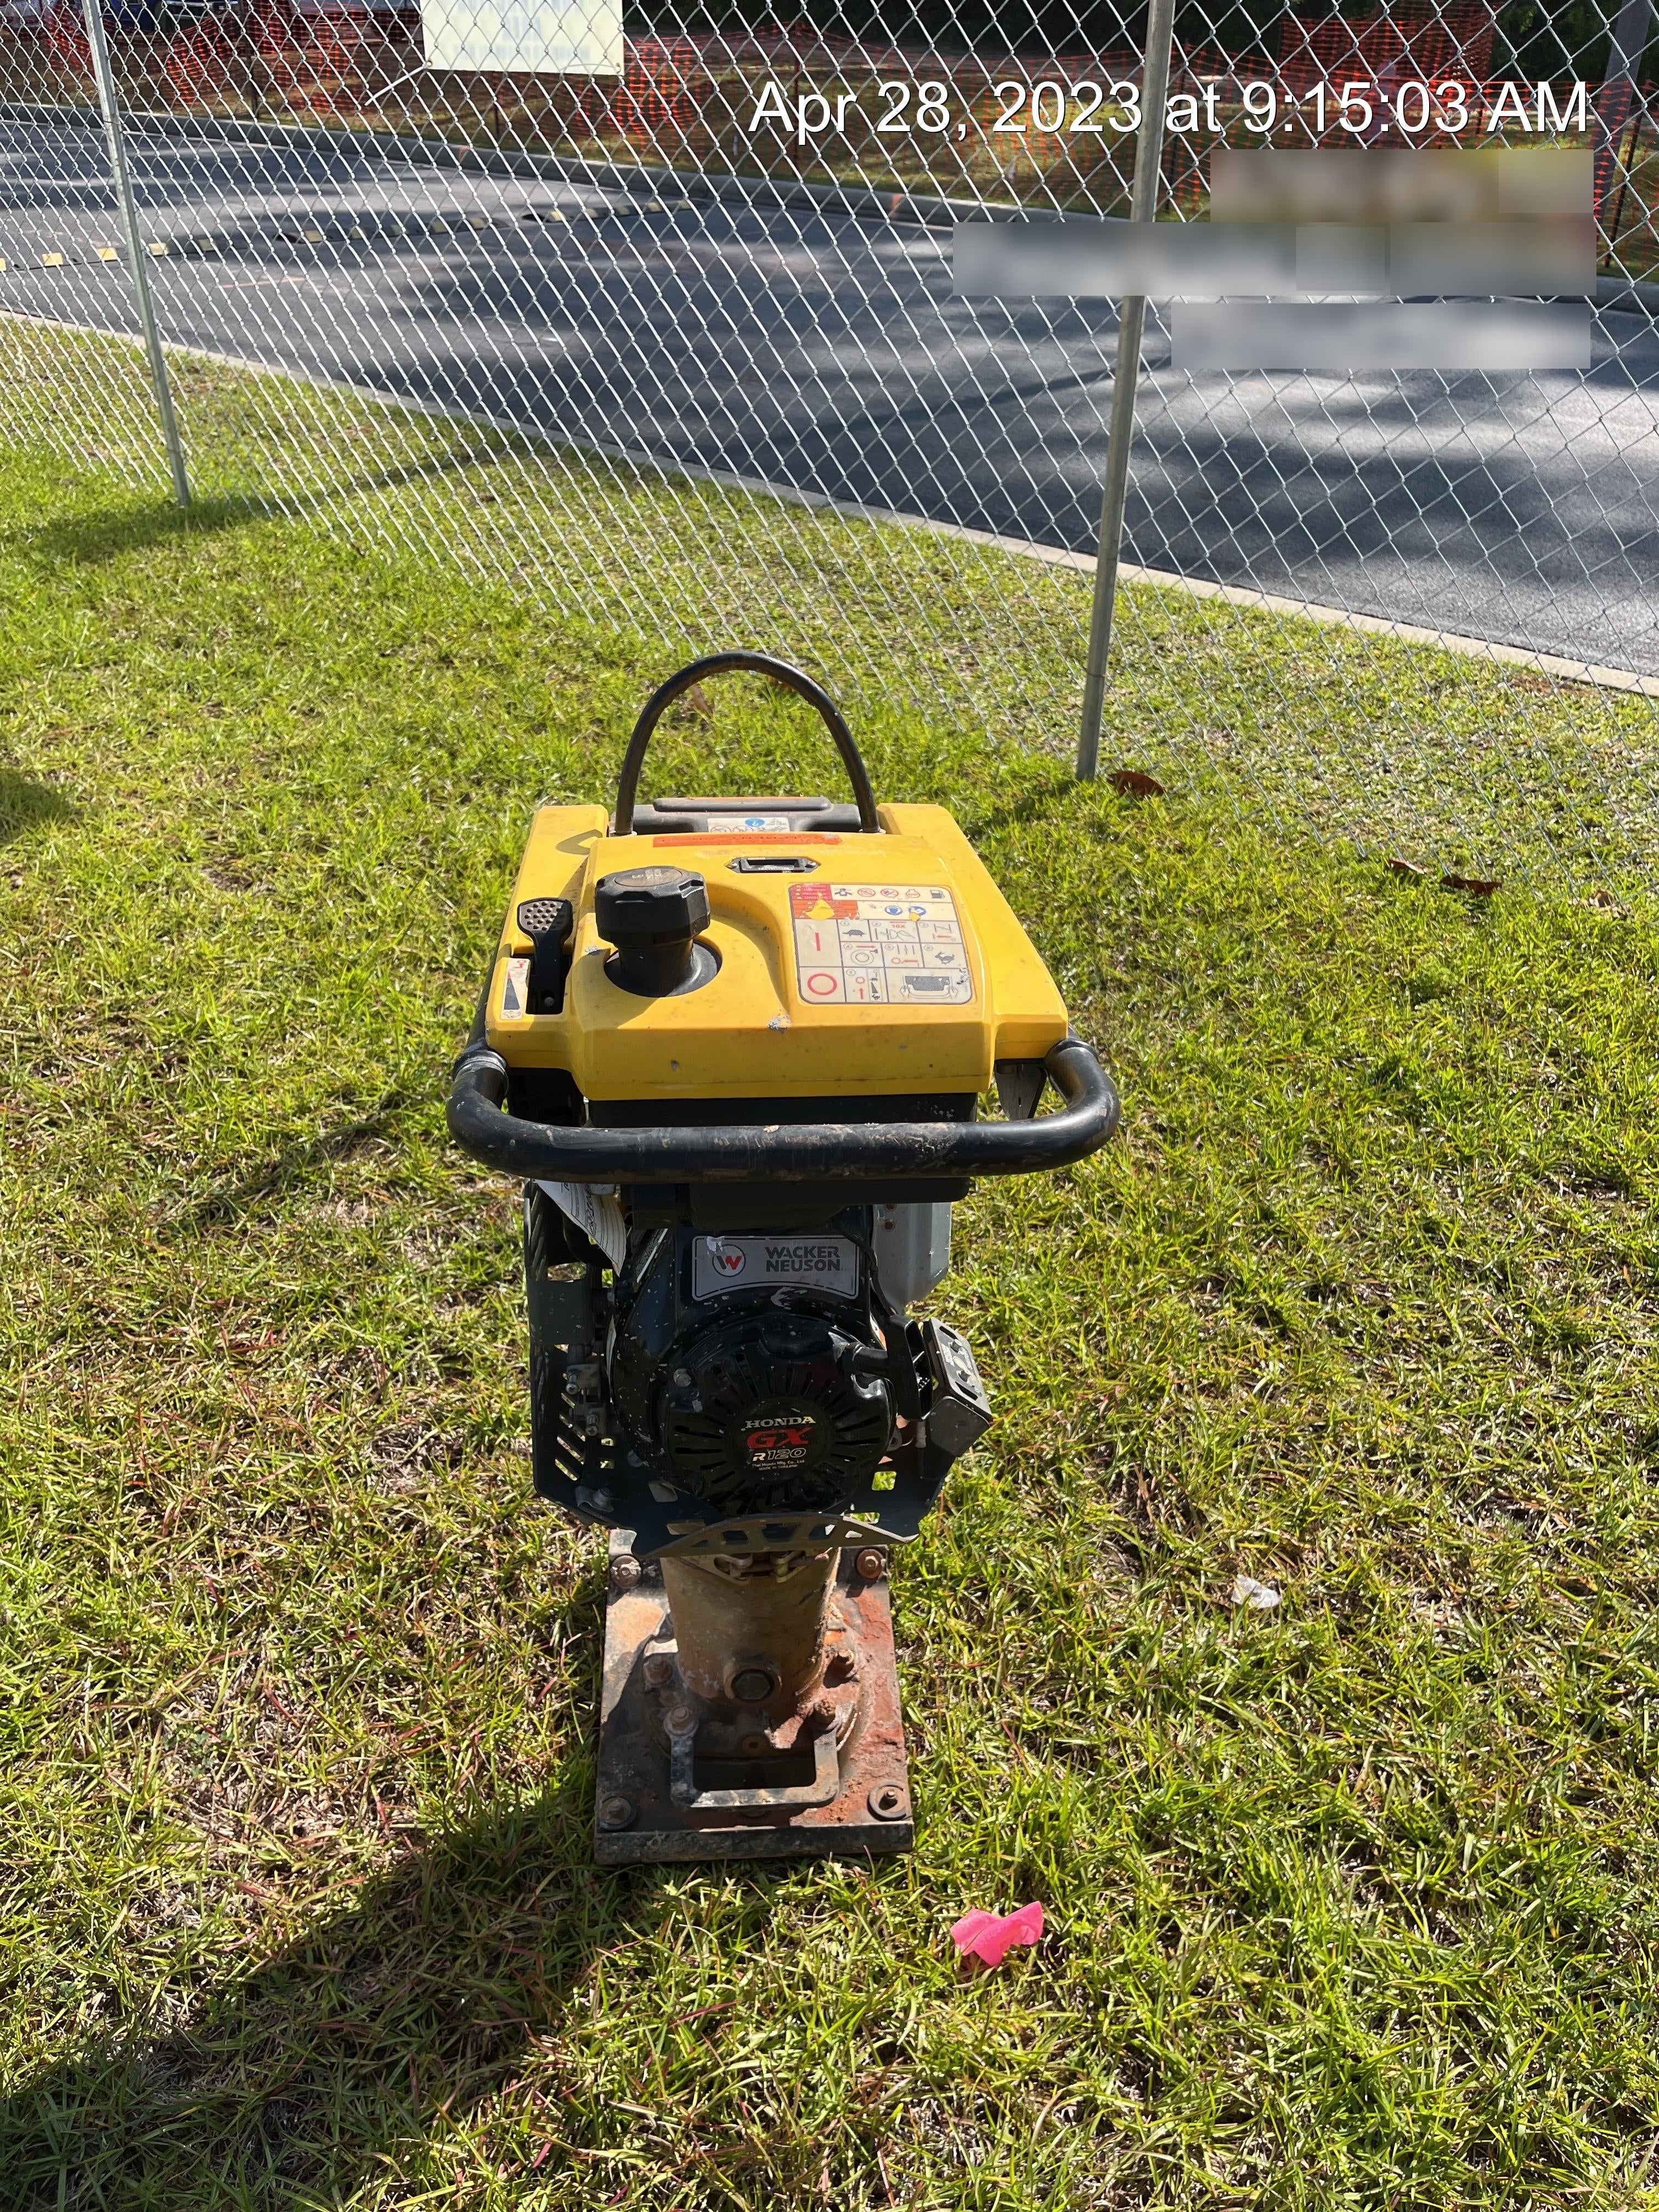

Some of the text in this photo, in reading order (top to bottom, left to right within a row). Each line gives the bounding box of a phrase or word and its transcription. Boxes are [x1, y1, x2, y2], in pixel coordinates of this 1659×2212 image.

[765, 1246, 840, 1259] WACKER
[766, 1259, 840, 1272] NEUSON
[746, 1417, 816, 1428] HONDA
[747, 1427, 812, 1448] GX
[753, 1448, 806, 1462] R120
